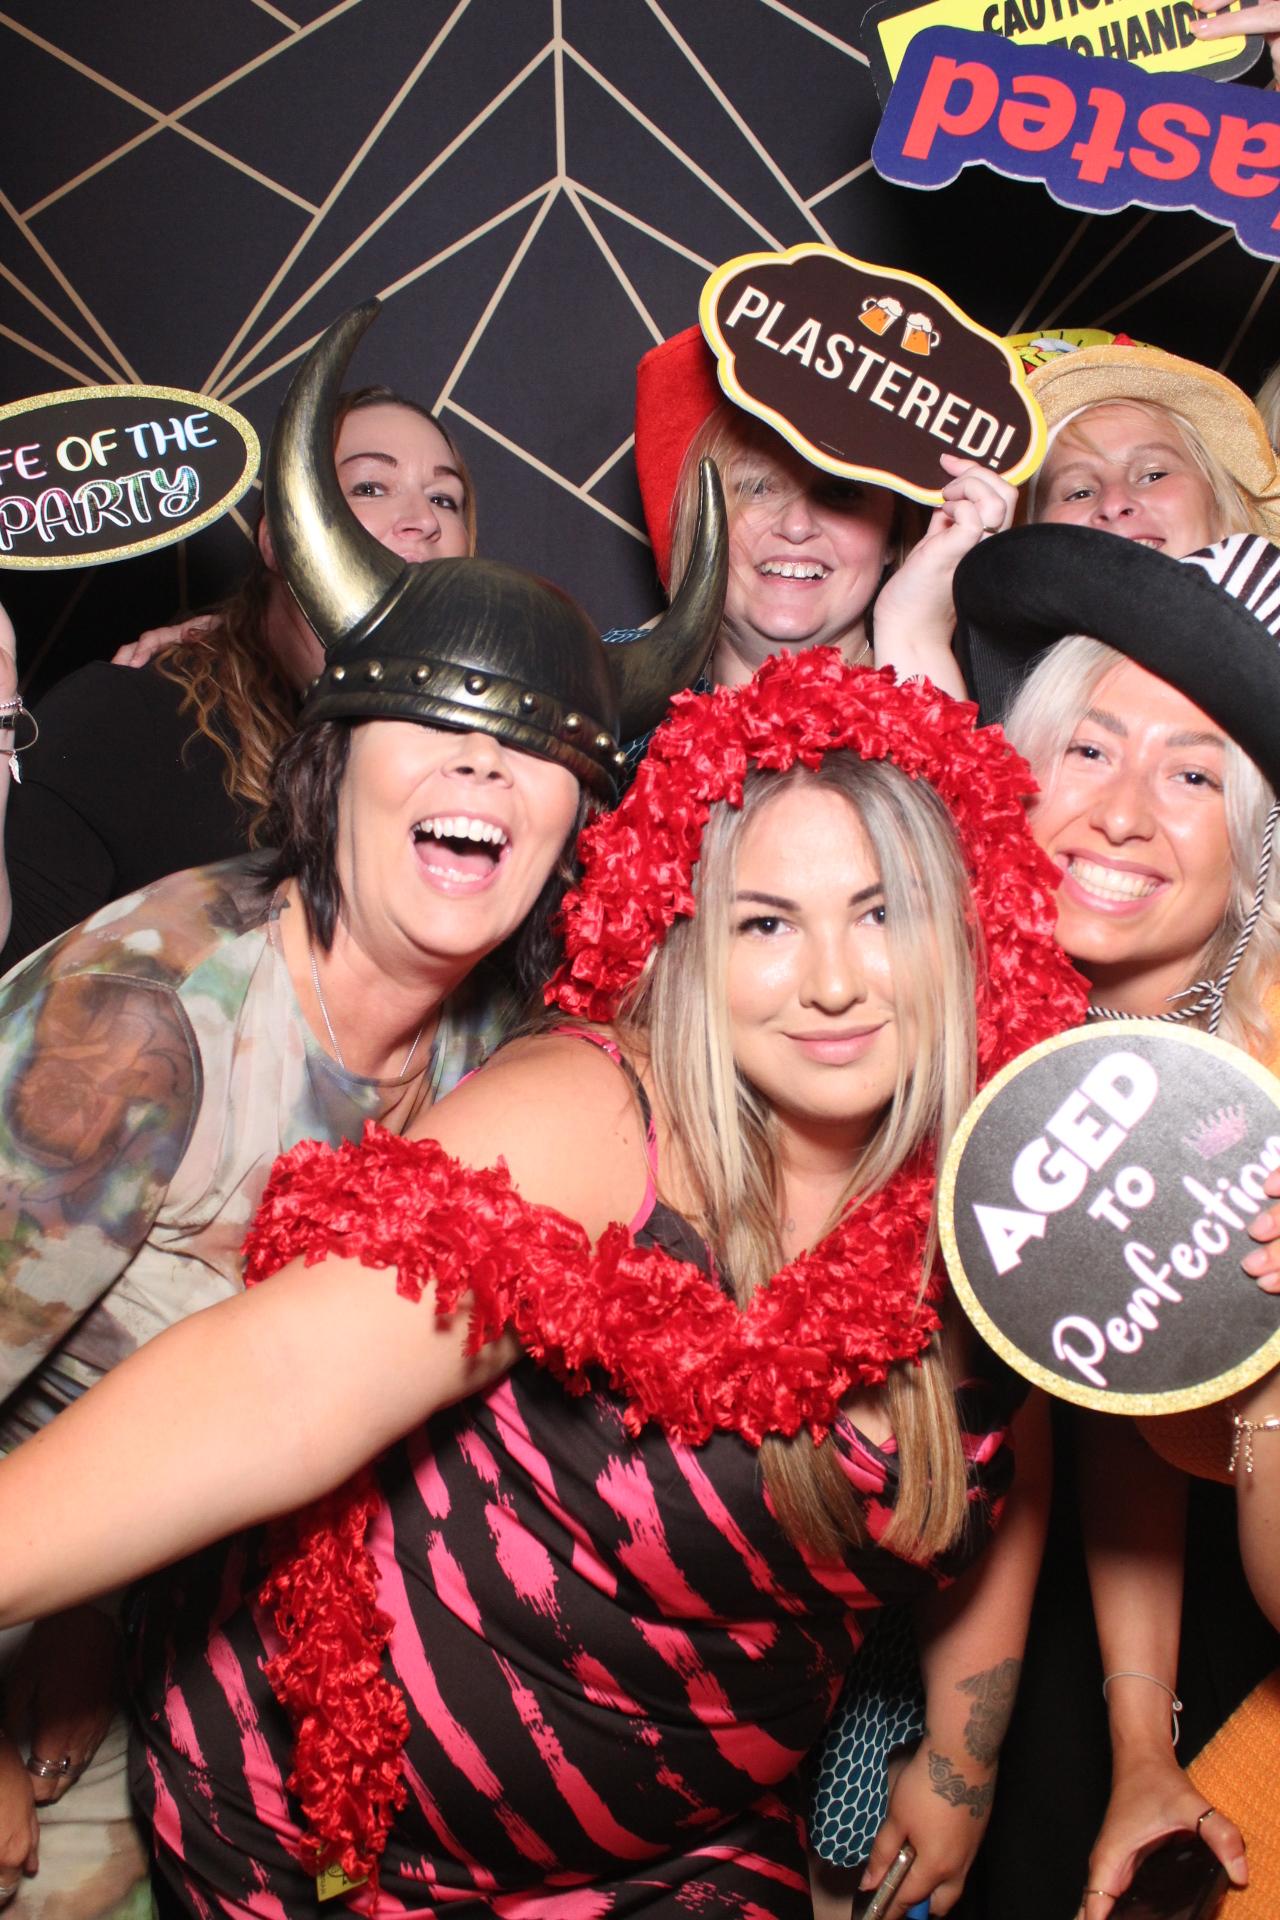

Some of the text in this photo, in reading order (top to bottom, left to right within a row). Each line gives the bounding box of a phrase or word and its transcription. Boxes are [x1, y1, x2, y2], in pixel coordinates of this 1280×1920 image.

[982, 0, 1115, 37] CAUT
[1098, 0, 1229, 61] HAND
[901, 55, 1280, 231] asted
[725, 286, 1016, 468] PLASTERED!
[0, 411, 218, 486] FE OF THE
[972, 1051, 1160, 1276] AGED
[1086, 1165, 1156, 1232] TO
